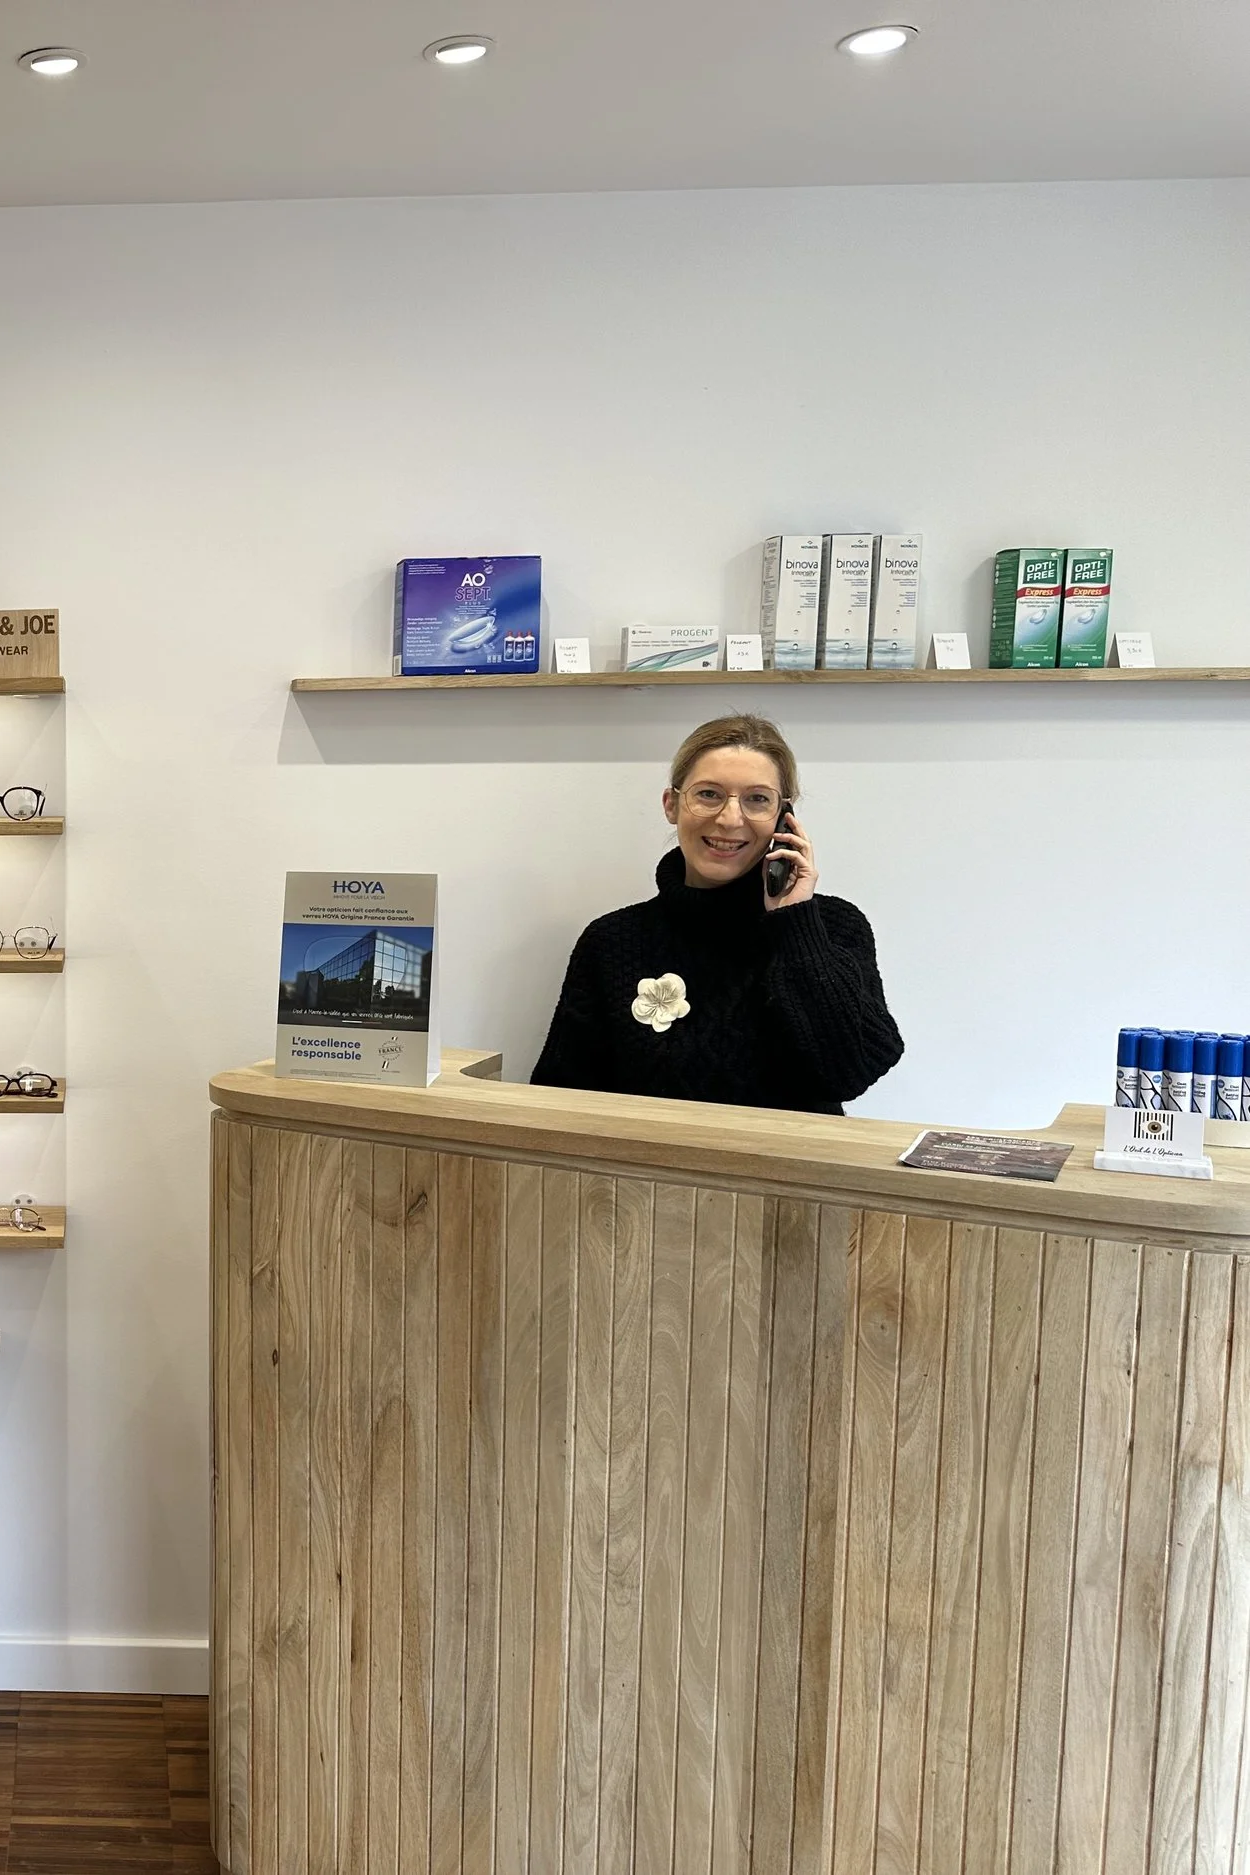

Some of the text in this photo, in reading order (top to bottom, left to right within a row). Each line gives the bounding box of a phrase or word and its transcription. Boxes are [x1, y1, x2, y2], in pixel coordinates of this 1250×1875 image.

[786, 559, 819, 569] binova
[836, 558, 869, 568] binova
[885, 557, 918, 568] binova
[1026, 561, 1055, 573] OPTI-
[1074, 561, 1104, 573] OPTI-
[460, 573, 486, 587] AO
[1026, 569, 1055, 581] FREE
[1074, 569, 1104, 581] FREE
[454, 586, 490, 602] SEPT
[1025, 588, 1053, 596] Express
[1073, 588, 1102, 596] Express
[0, 616, 14, 635] &
[20, 615, 55, 635] JOE
[670, 629, 714, 637] PROGENT
[331, 881, 385, 894] HOYA
[292, 1036, 361, 1049] L'excellence
[291, 1048, 362, 1060] responsable
